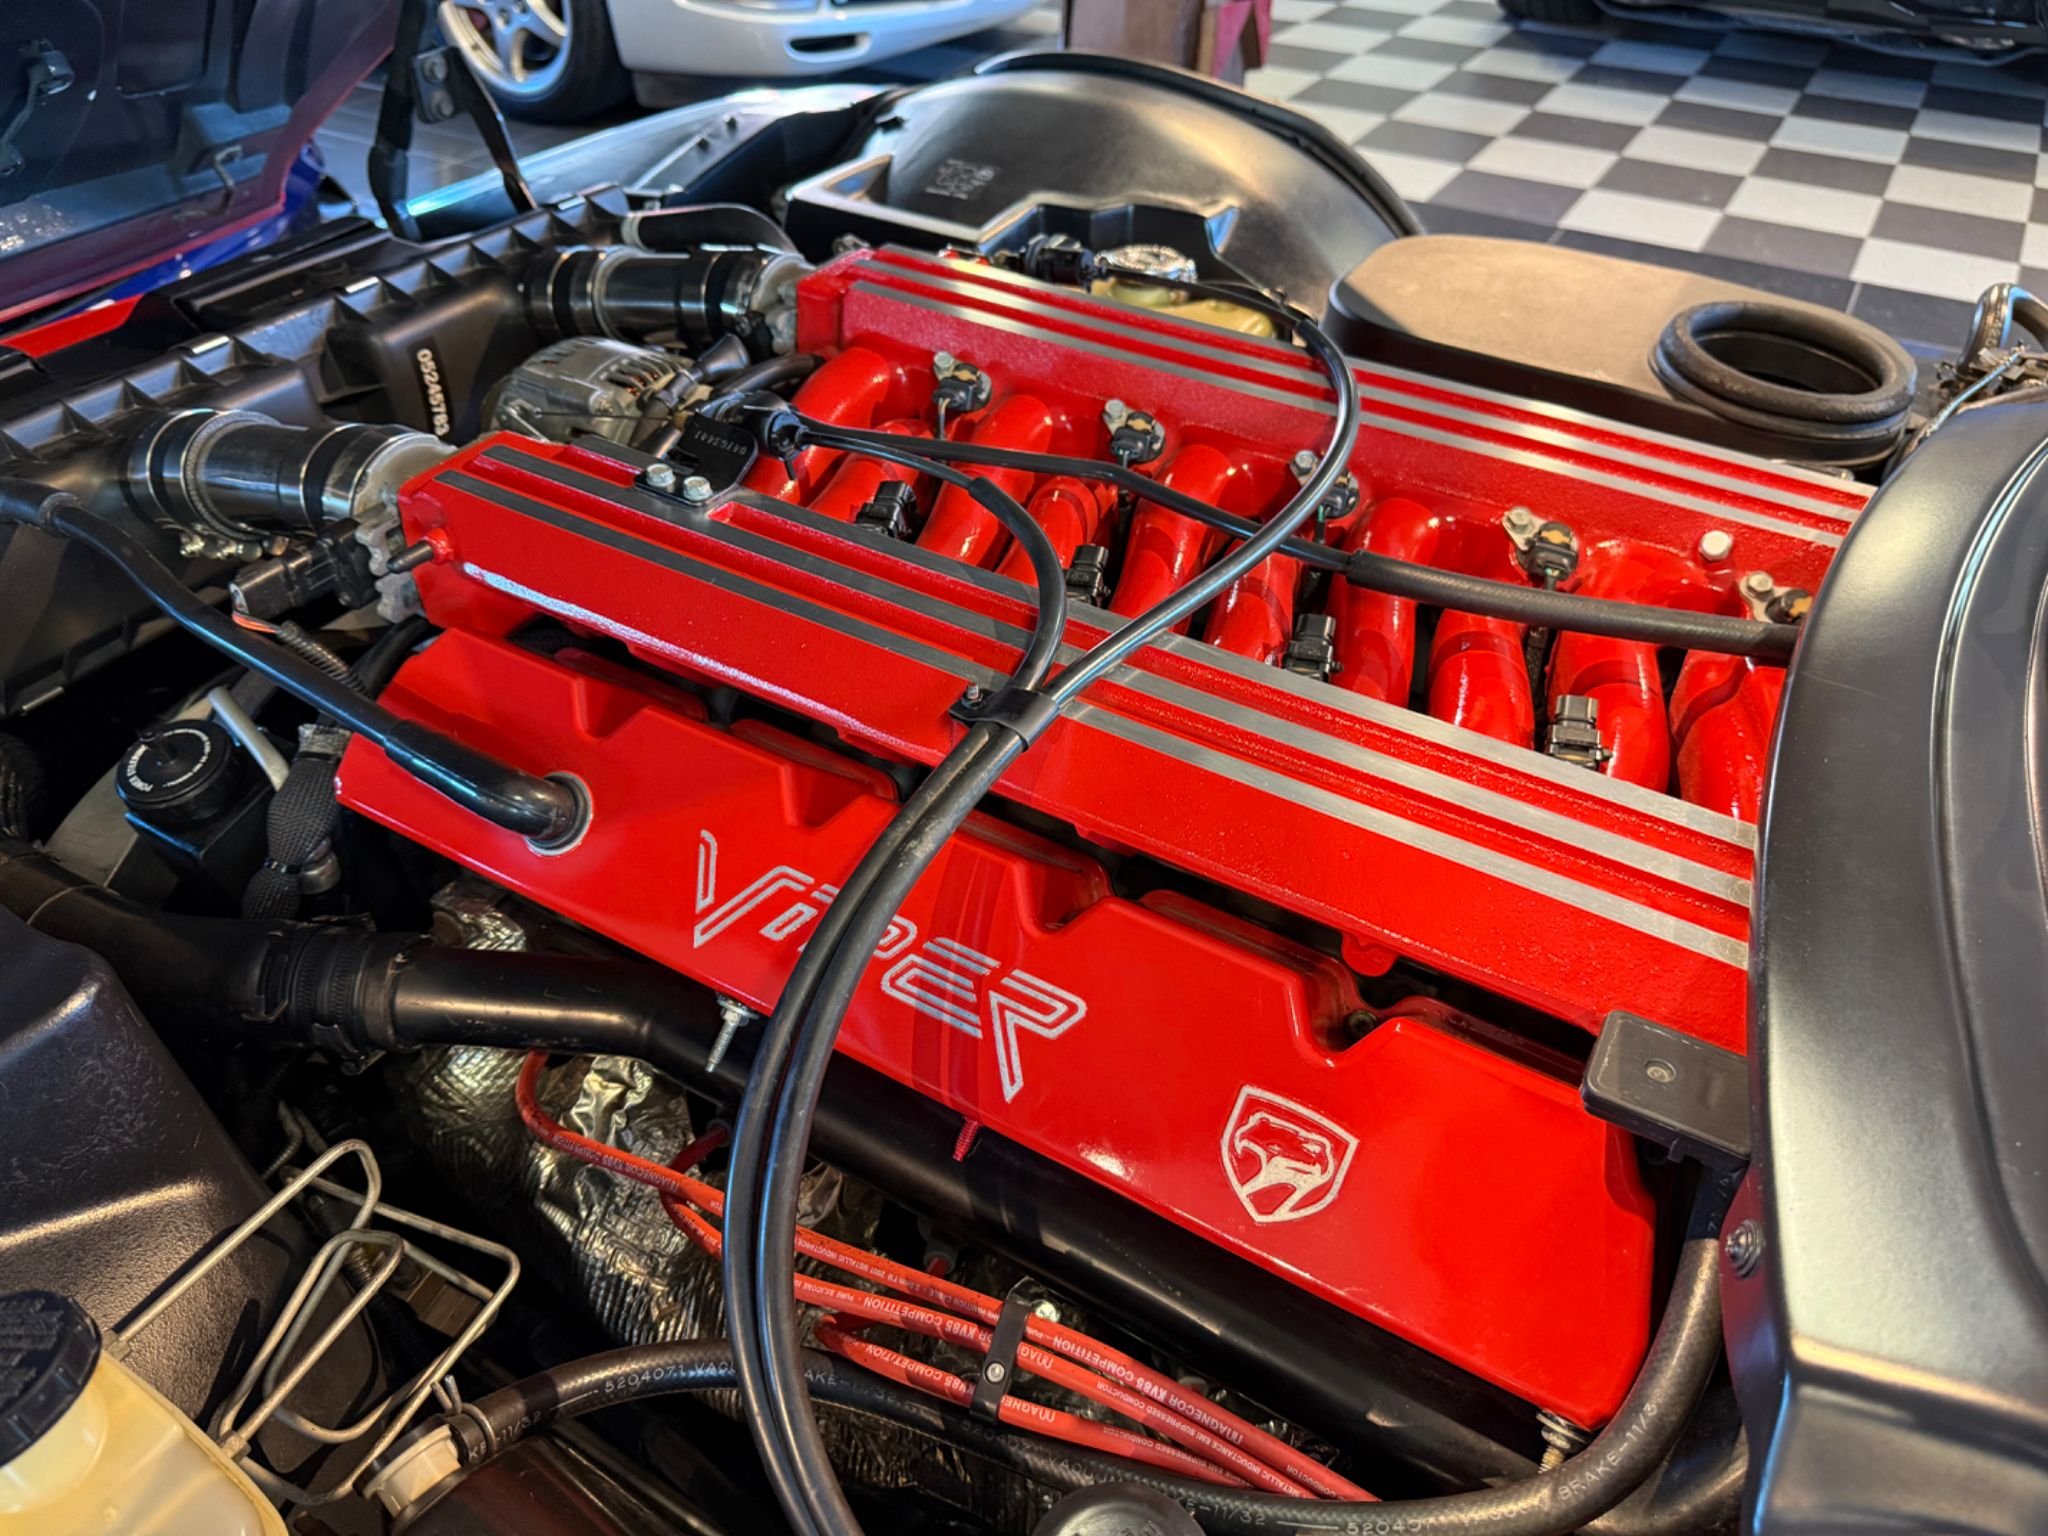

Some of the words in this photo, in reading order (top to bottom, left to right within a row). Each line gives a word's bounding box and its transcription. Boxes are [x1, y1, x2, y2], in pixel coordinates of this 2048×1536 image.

[626, 1165, 680, 1193] MAGNECOR
[798, 1238, 838, 1260] INDUCTANCE
[864, 1296, 944, 1325] COMPETITION
[945, 1320, 977, 1340] KV85
[865, 1343, 944, 1382] COMPETITION
[979, 1331, 1054, 1370] MAGOR
[1053, 1335, 1135, 1382] COMPETITION
[603, 1363, 686, 1394] 5204071
[804, 1370, 897, 1402] AKE-11/32
[945, 1375, 976, 1396] KV85
[1136, 1377, 1168, 1403] KV85
[1096, 1381, 1146, 1408] CONDUCTOR
[1001, 1395, 1057, 1424] MAGNE
[1146, 1405, 1197, 1437] SUPPRESSED
[1168, 1393, 1244, 1446] MAGNECOR
[1103, 1426, 1154, 1448] CONDUCTOR
[1195, 1431, 1213, 1444] EMI
[1211, 1442, 1262, 1477] INDUCTANCE
[1260, 1469, 1301, 1498] METALLIC
[1286, 1463, 1337, 1498] CONDUCTOR
